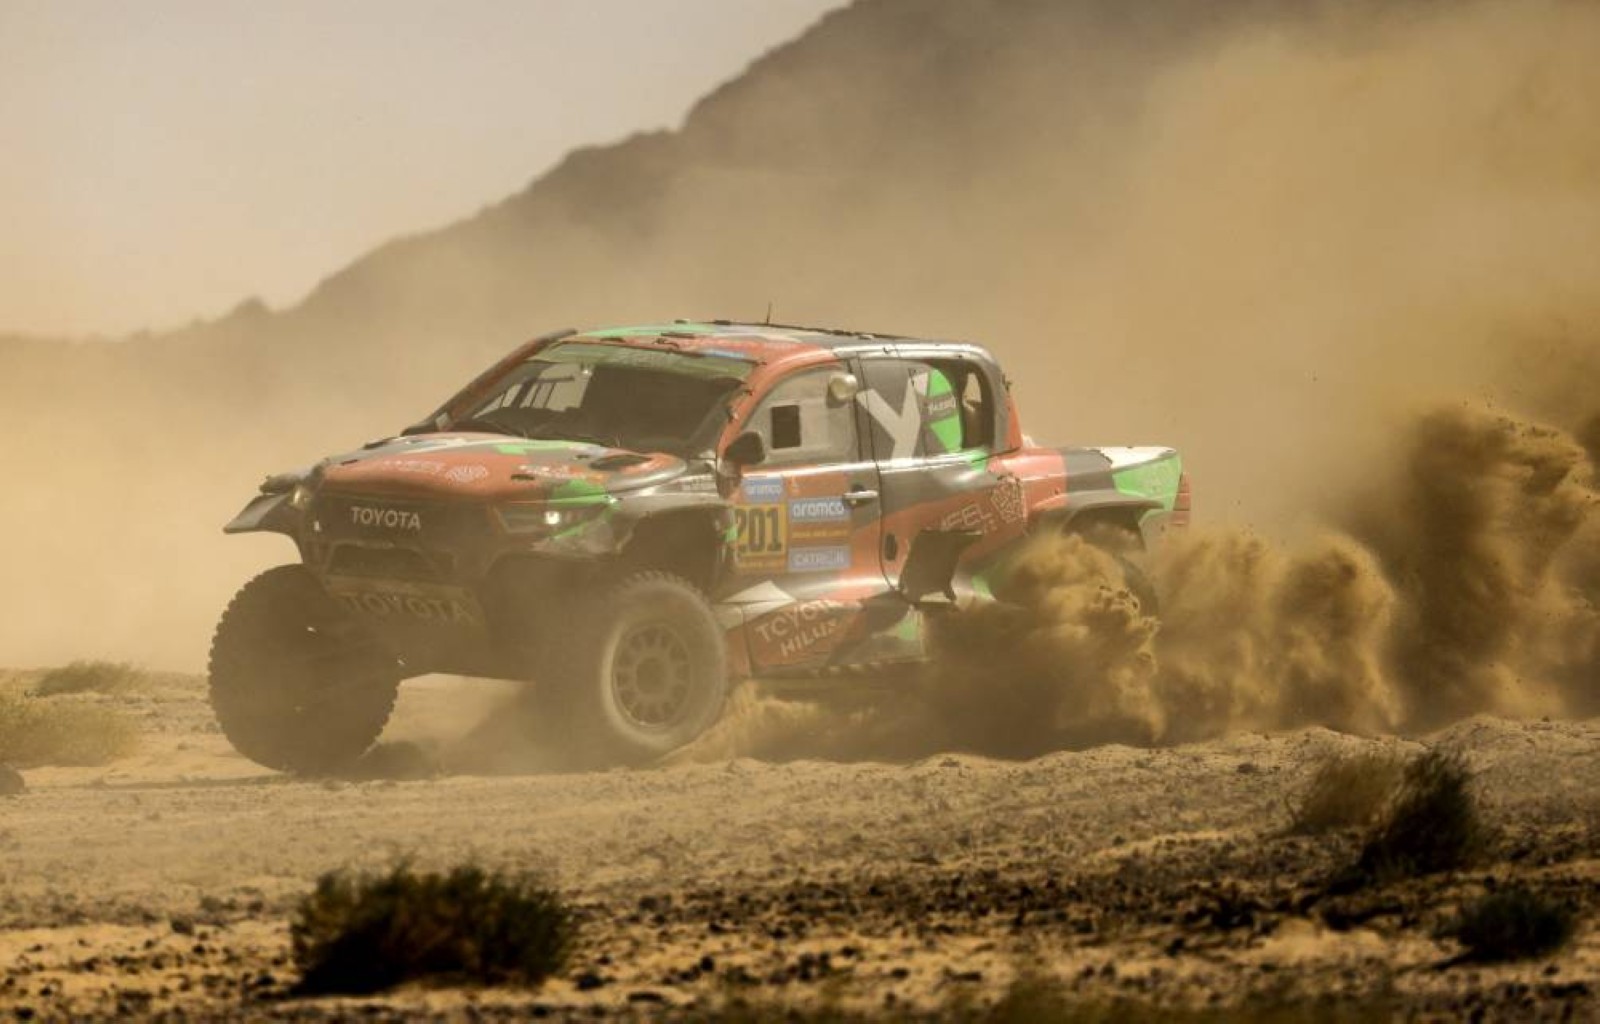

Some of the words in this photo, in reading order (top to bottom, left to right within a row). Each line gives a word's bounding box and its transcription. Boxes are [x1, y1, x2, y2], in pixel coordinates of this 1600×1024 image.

[351, 505, 421, 529] TOYOTA
[793, 501, 845, 517] aramco
[735, 507, 783, 556] 201
[336, 591, 475, 626] TOYOTA
